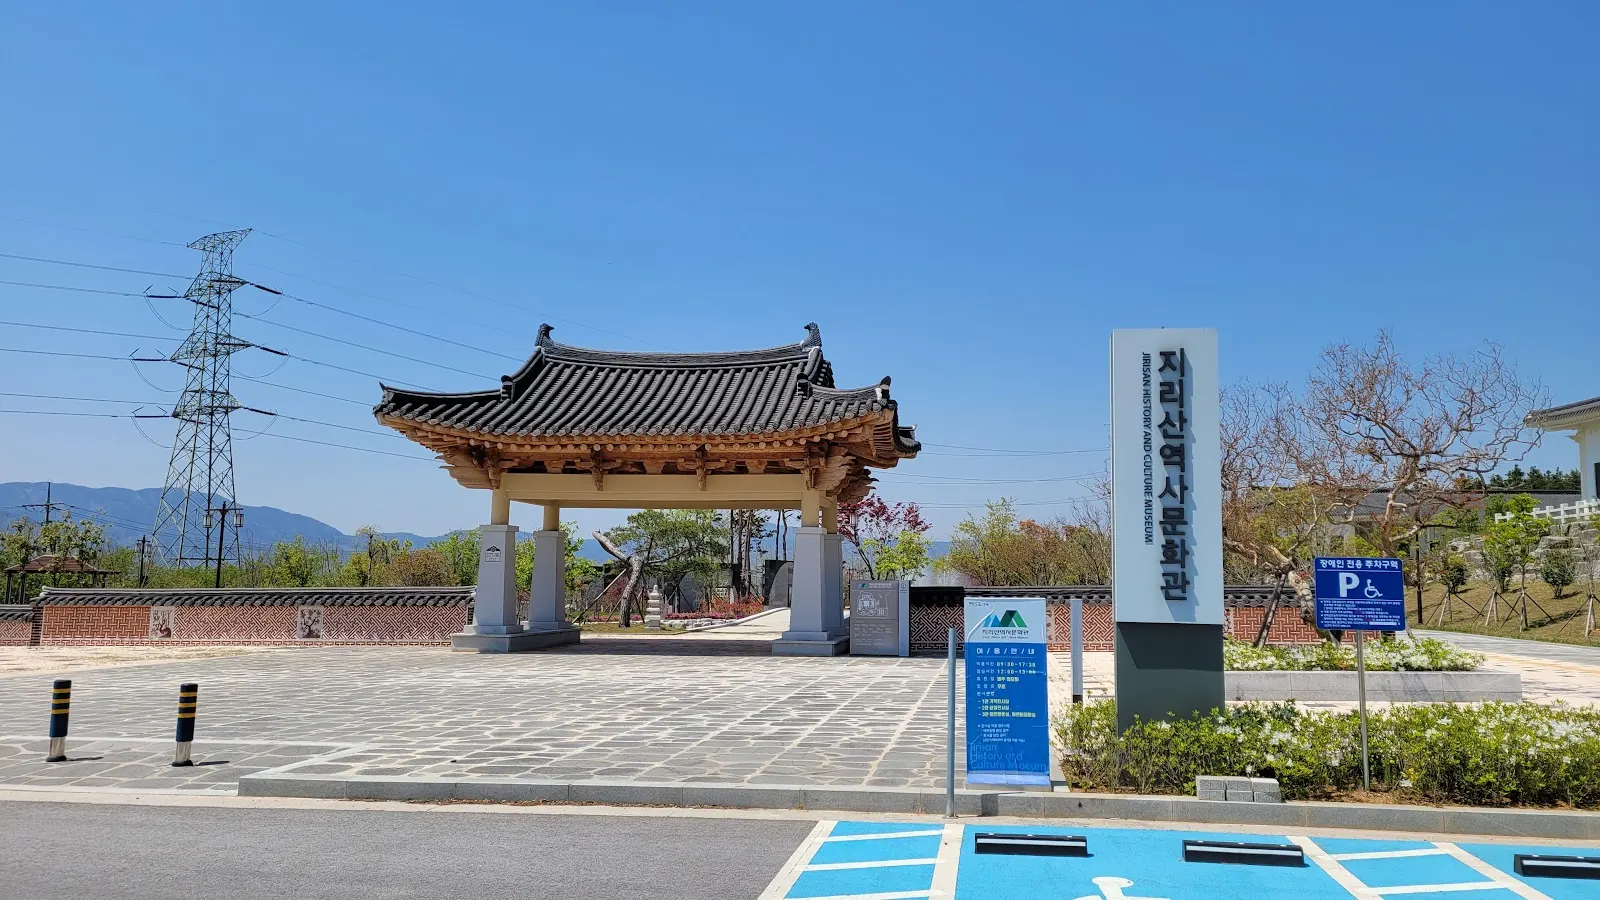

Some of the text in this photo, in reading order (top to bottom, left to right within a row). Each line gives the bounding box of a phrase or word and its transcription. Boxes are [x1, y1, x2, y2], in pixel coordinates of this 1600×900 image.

[1142, 352, 1153, 543] JIRISAN HISTORY AND CULTURE MUSEUM
[1158, 348, 1190, 601] 지리산역사문화관
[1320, 560, 1399, 569] 장애인 전용 주차구역
[1338, 572, 1360, 597] P
[970, 751, 1002, 761] History
[970, 760, 1005, 769] Culture
